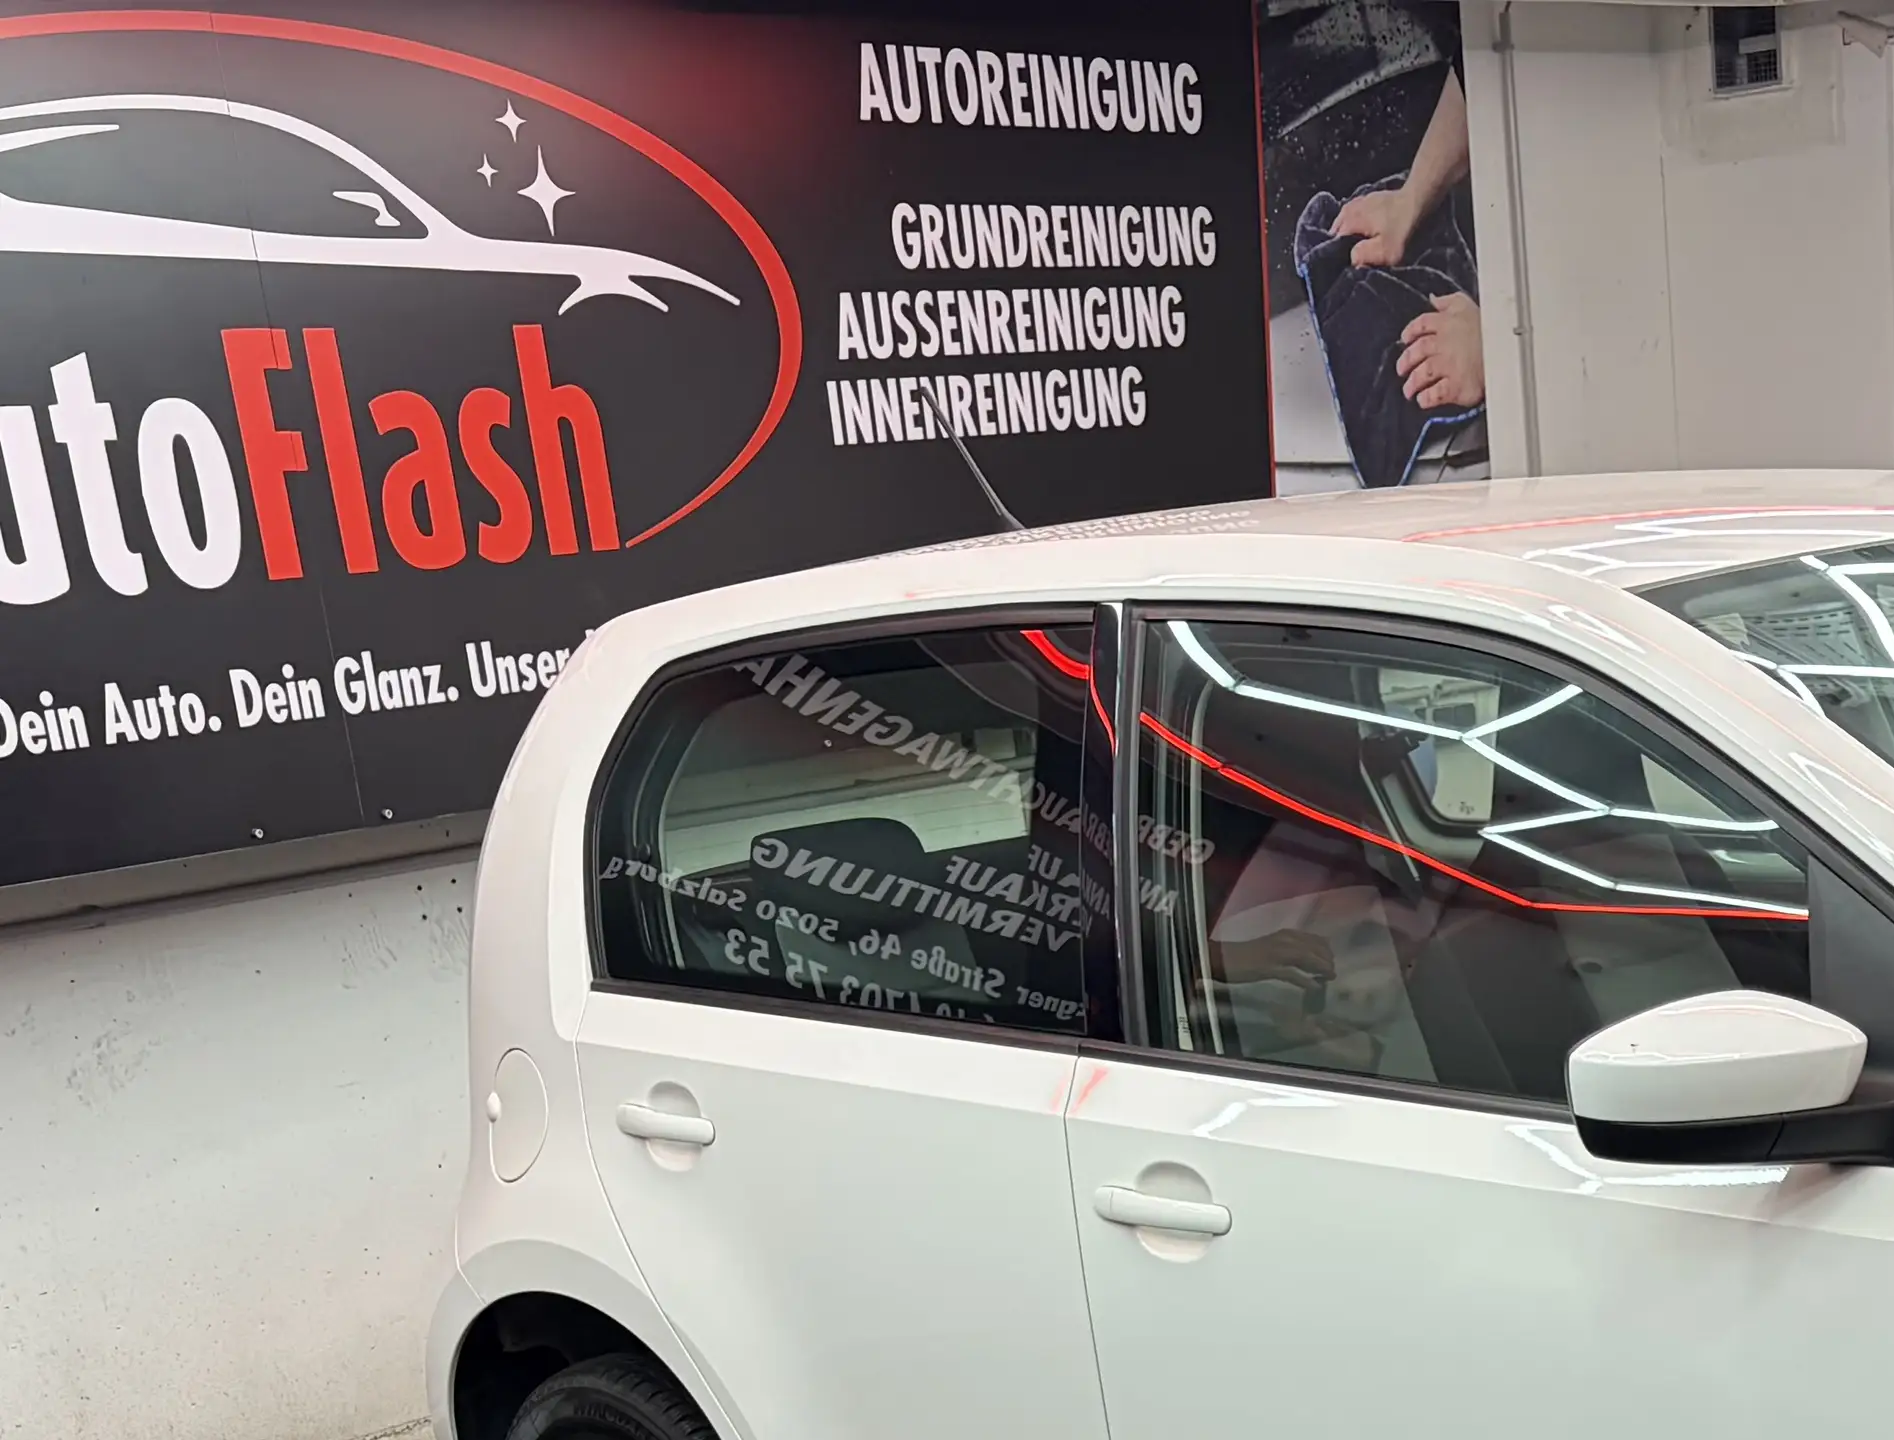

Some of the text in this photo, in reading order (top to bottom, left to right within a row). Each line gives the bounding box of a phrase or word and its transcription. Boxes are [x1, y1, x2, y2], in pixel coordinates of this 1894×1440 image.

[860, 42, 1202, 134] AUTOREINIGUNG
[891, 202, 1217, 269] GRUNDREINIGUNG
[838, 285, 1186, 360] AUSSENREINIGUNG
[826, 365, 1147, 446] INNENREINIGUNG
[0, 691, 90, 758] Dein
[104, 682, 222, 745] Auto.
[229, 663, 326, 728] Dein
[334, 651, 459, 715] Glanz.
